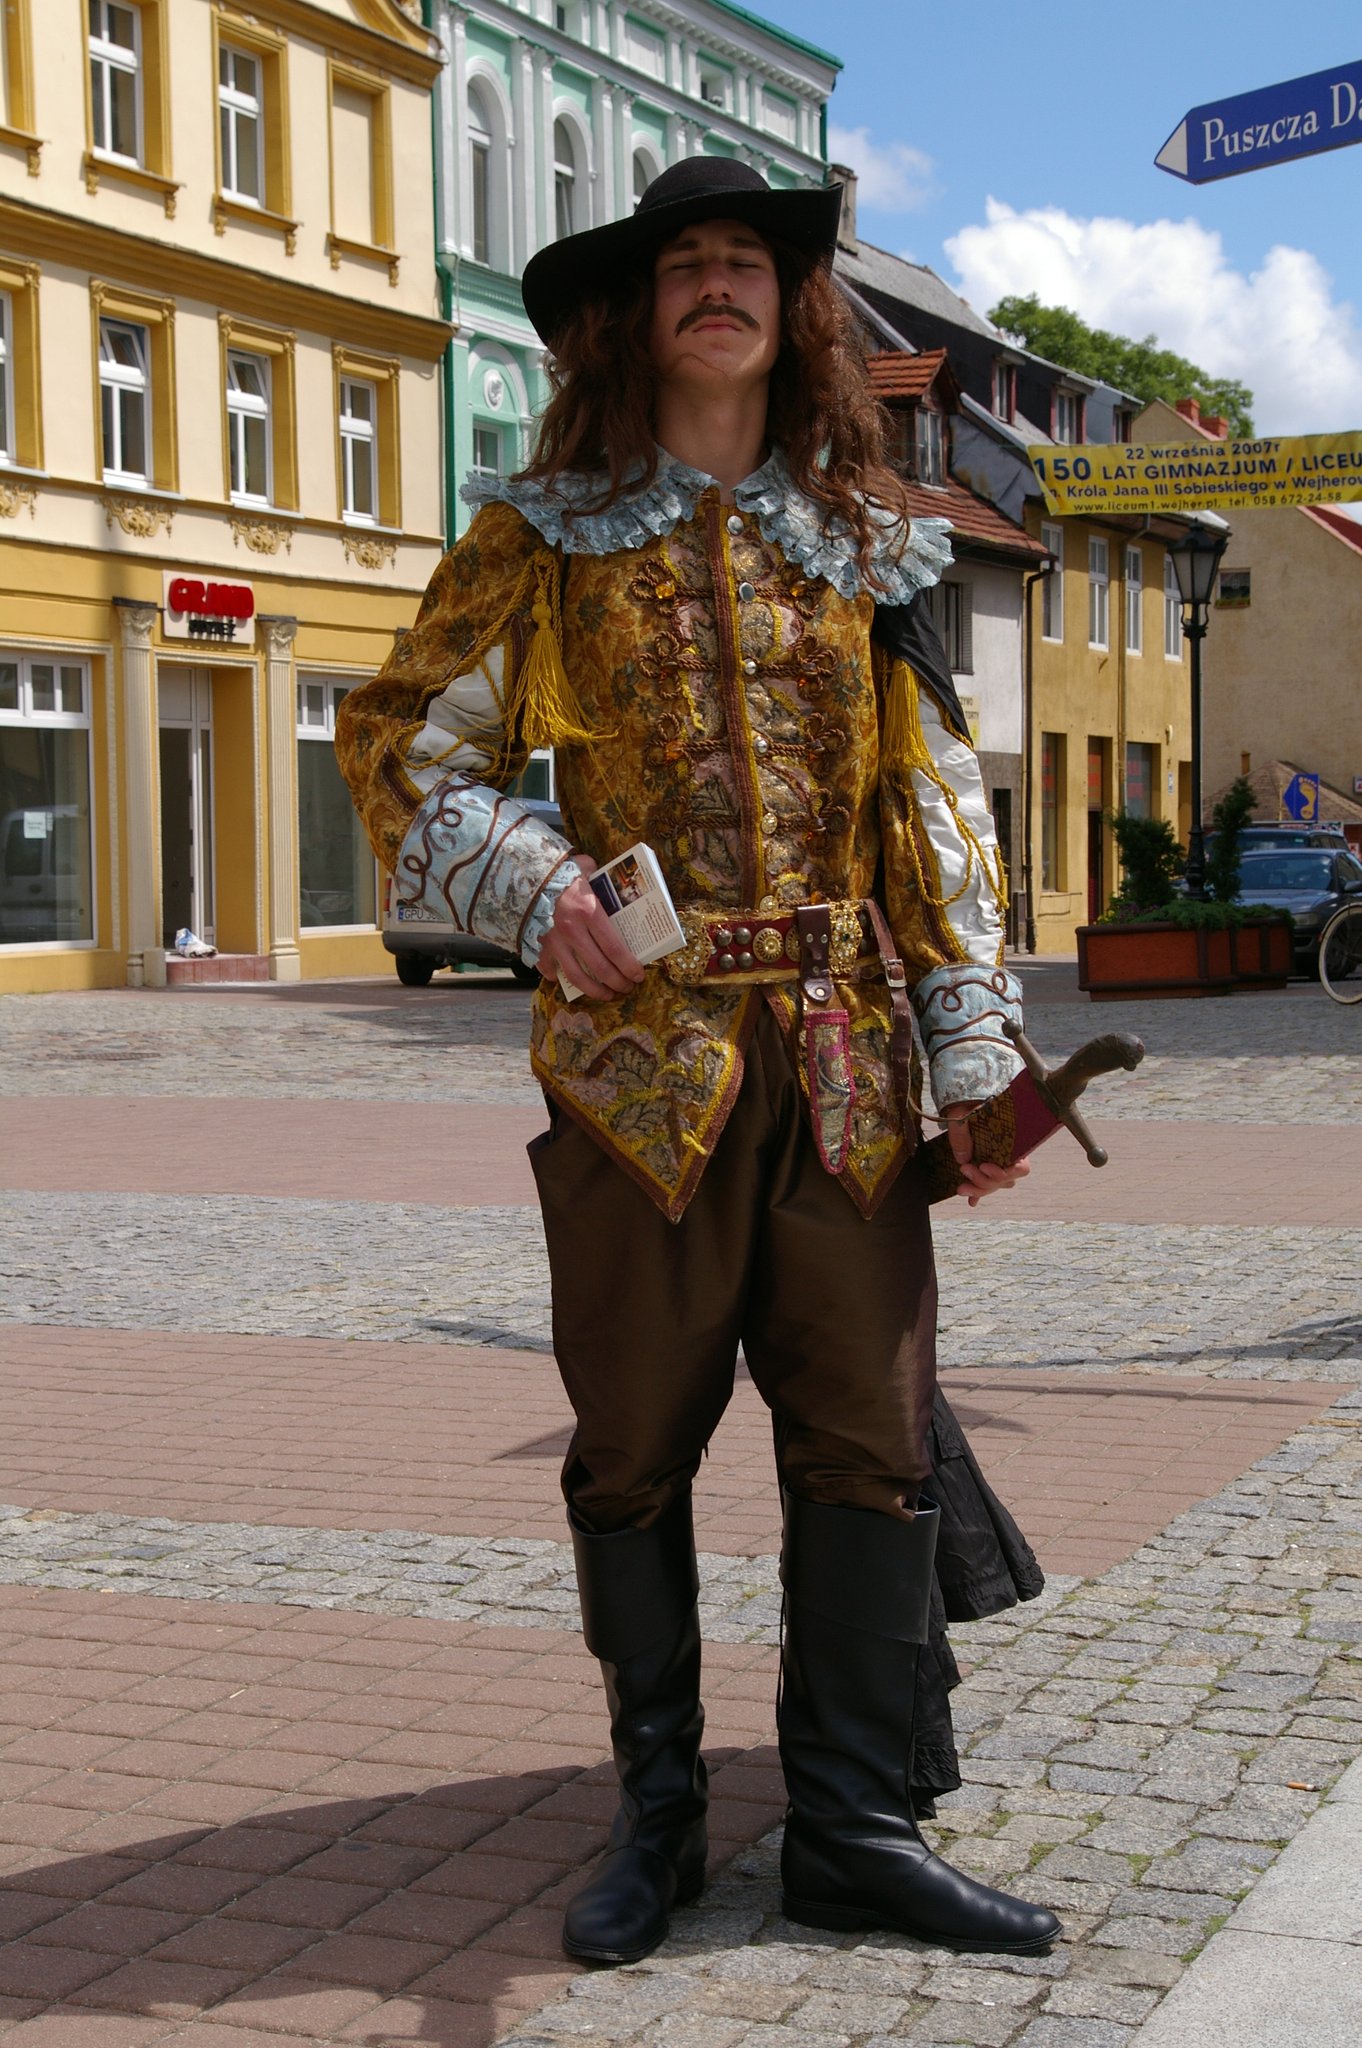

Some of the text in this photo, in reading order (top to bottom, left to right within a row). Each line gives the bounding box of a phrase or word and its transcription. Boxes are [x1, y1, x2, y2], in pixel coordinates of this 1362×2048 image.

[1202, 82, 1362, 163] Puszcza D
[1126, 441, 1280, 460] 22 września 2007r
[1034, 453, 1362, 482] 150 LAT GIMNAZJUM / LICEU
[1068, 484, 1107, 497] Króla
[1113, 484, 1149, 496] Jana
[1154, 484, 1168, 495] III
[1174, 480, 1269, 496] Sobieskiego
[1274, 480, 1286, 490] w
[1229, 496, 1249, 507] tel.
[1254, 495, 1276, 505] 058
[1281, 491, 1342, 504] 672-24-58
[405, 909, 424, 920] GPU
